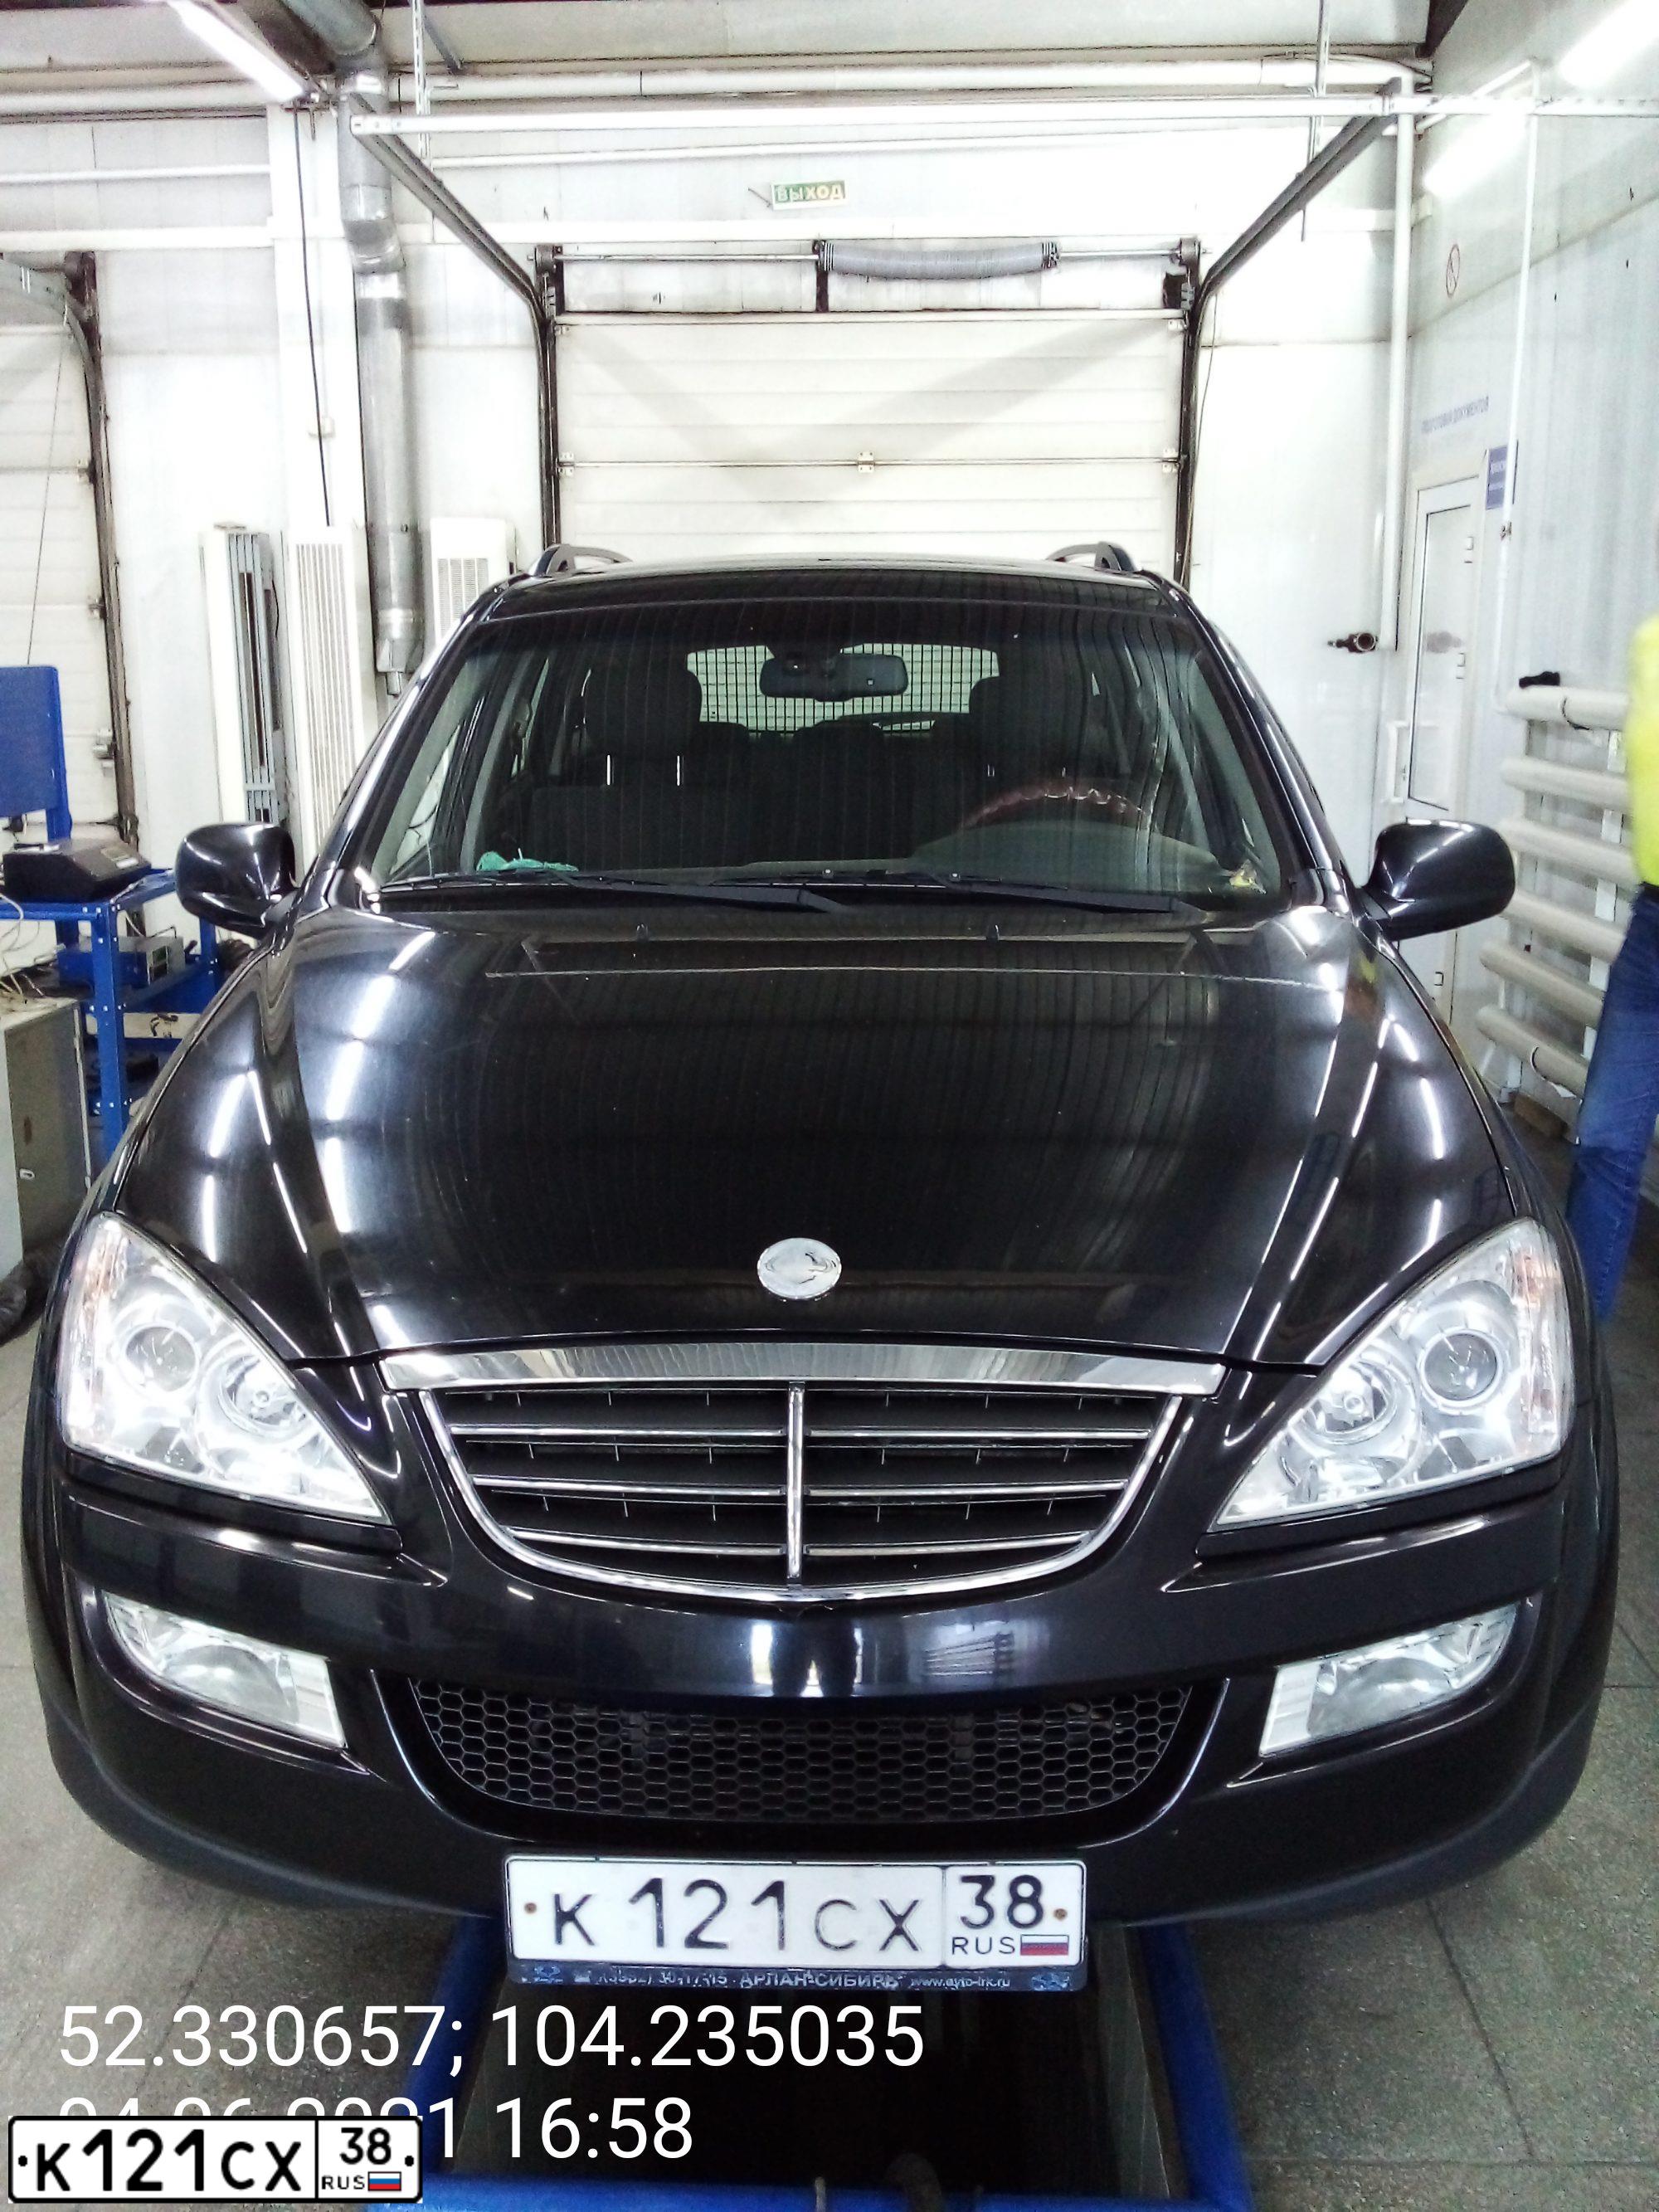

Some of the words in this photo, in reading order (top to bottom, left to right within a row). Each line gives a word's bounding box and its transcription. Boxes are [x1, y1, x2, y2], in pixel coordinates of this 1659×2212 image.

[777, 183, 844, 202] ВЫХОД
[960, 1874, 1044, 1929] 38
[951, 1936, 1015, 1956] RUS
